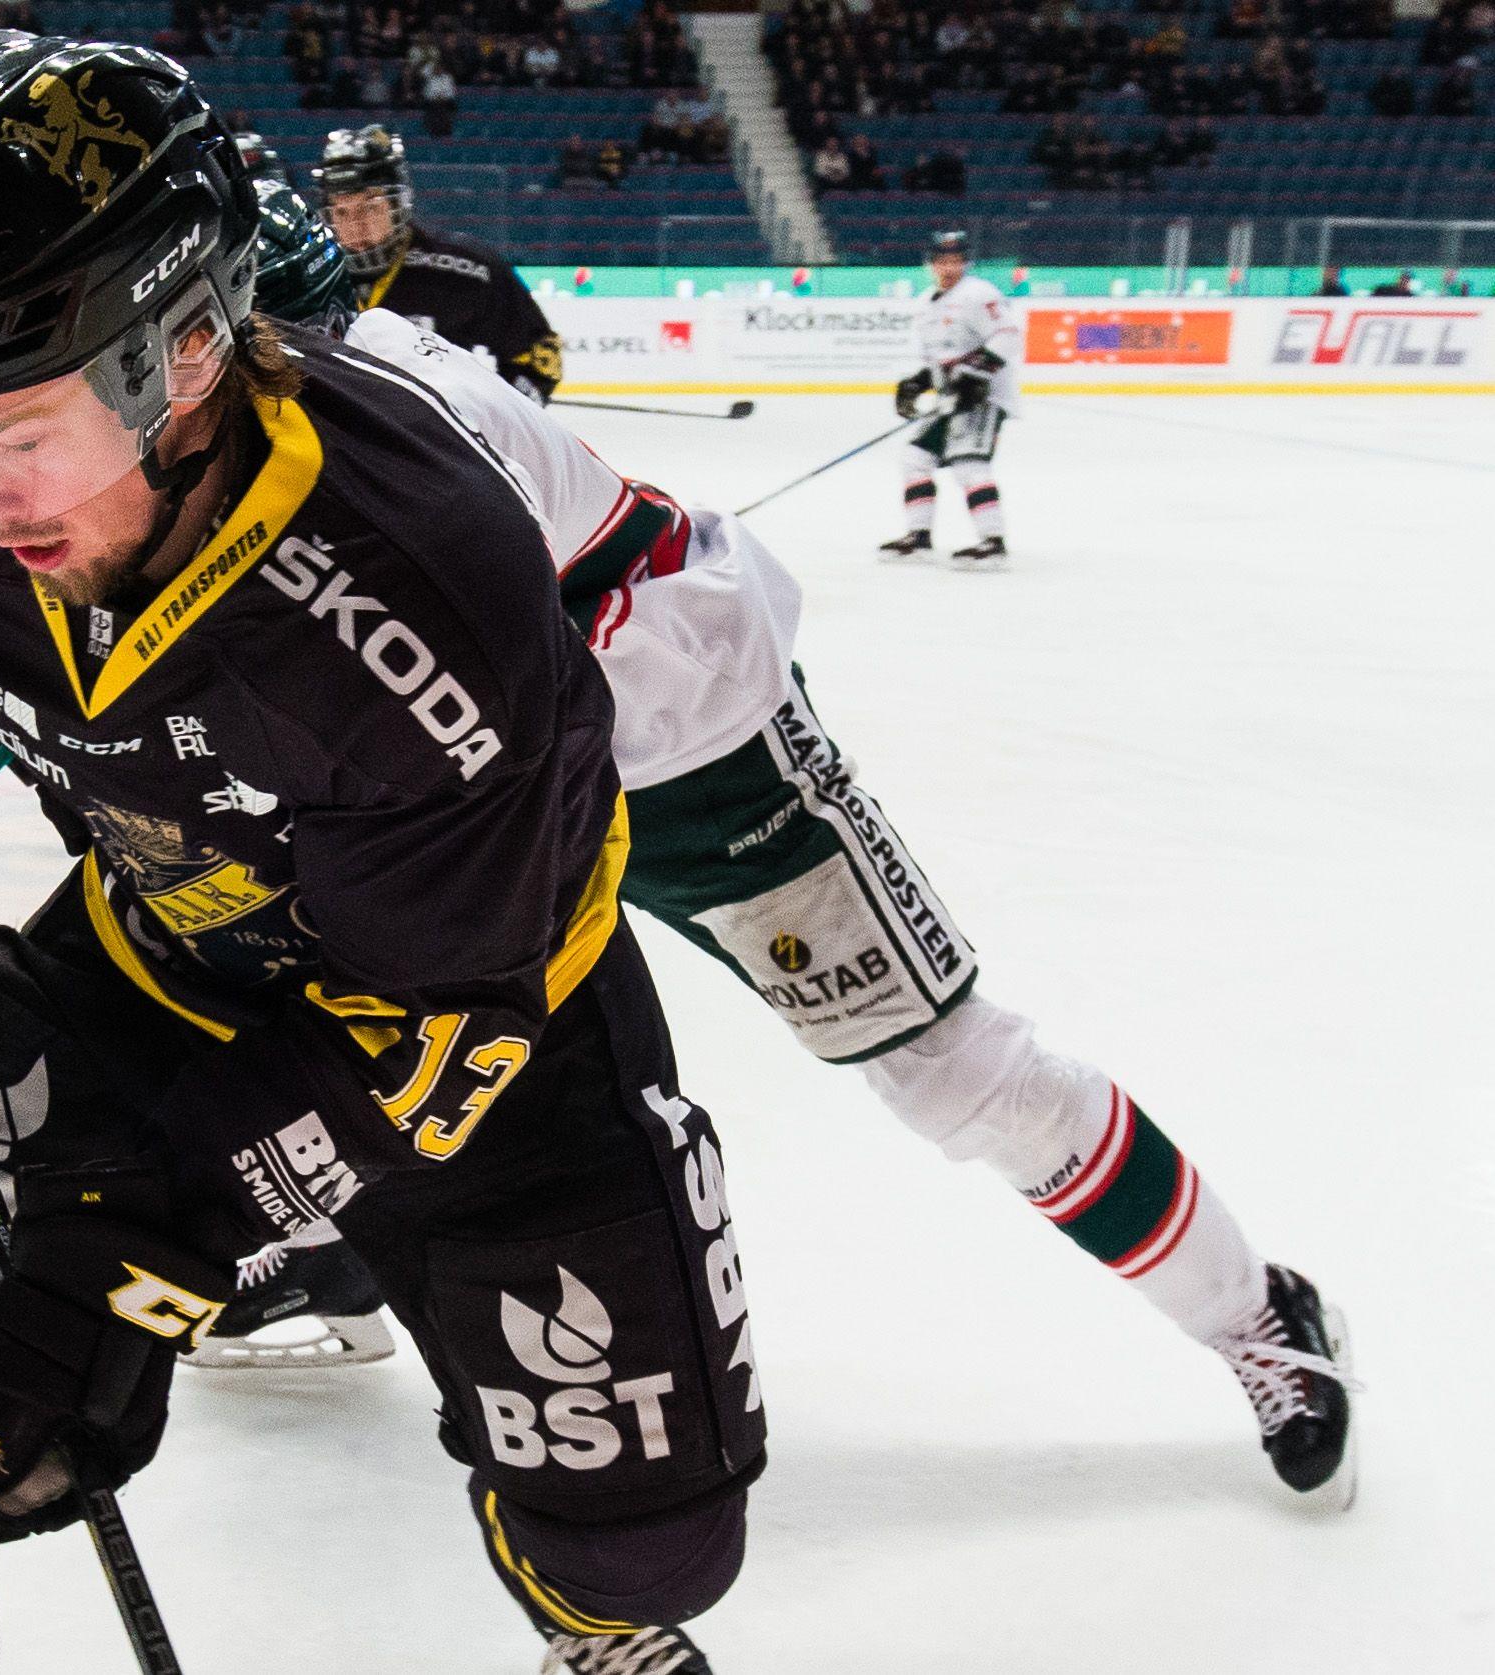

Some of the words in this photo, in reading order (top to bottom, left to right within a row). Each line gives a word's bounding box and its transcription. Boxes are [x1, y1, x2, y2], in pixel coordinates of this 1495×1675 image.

[130, 222, 201, 303] CCM
[598, 336, 648, 353] SPEL
[742, 305, 915, 332] Klockmaster
[146, 408, 171, 438] CCM
[258, 533, 504, 783] ŠKODA
[58, 733, 144, 755] CCM
[369, 1012, 531, 1162] 13
[231, 1148, 293, 1226] SMIDE
[474, 1370, 675, 1471] BST
